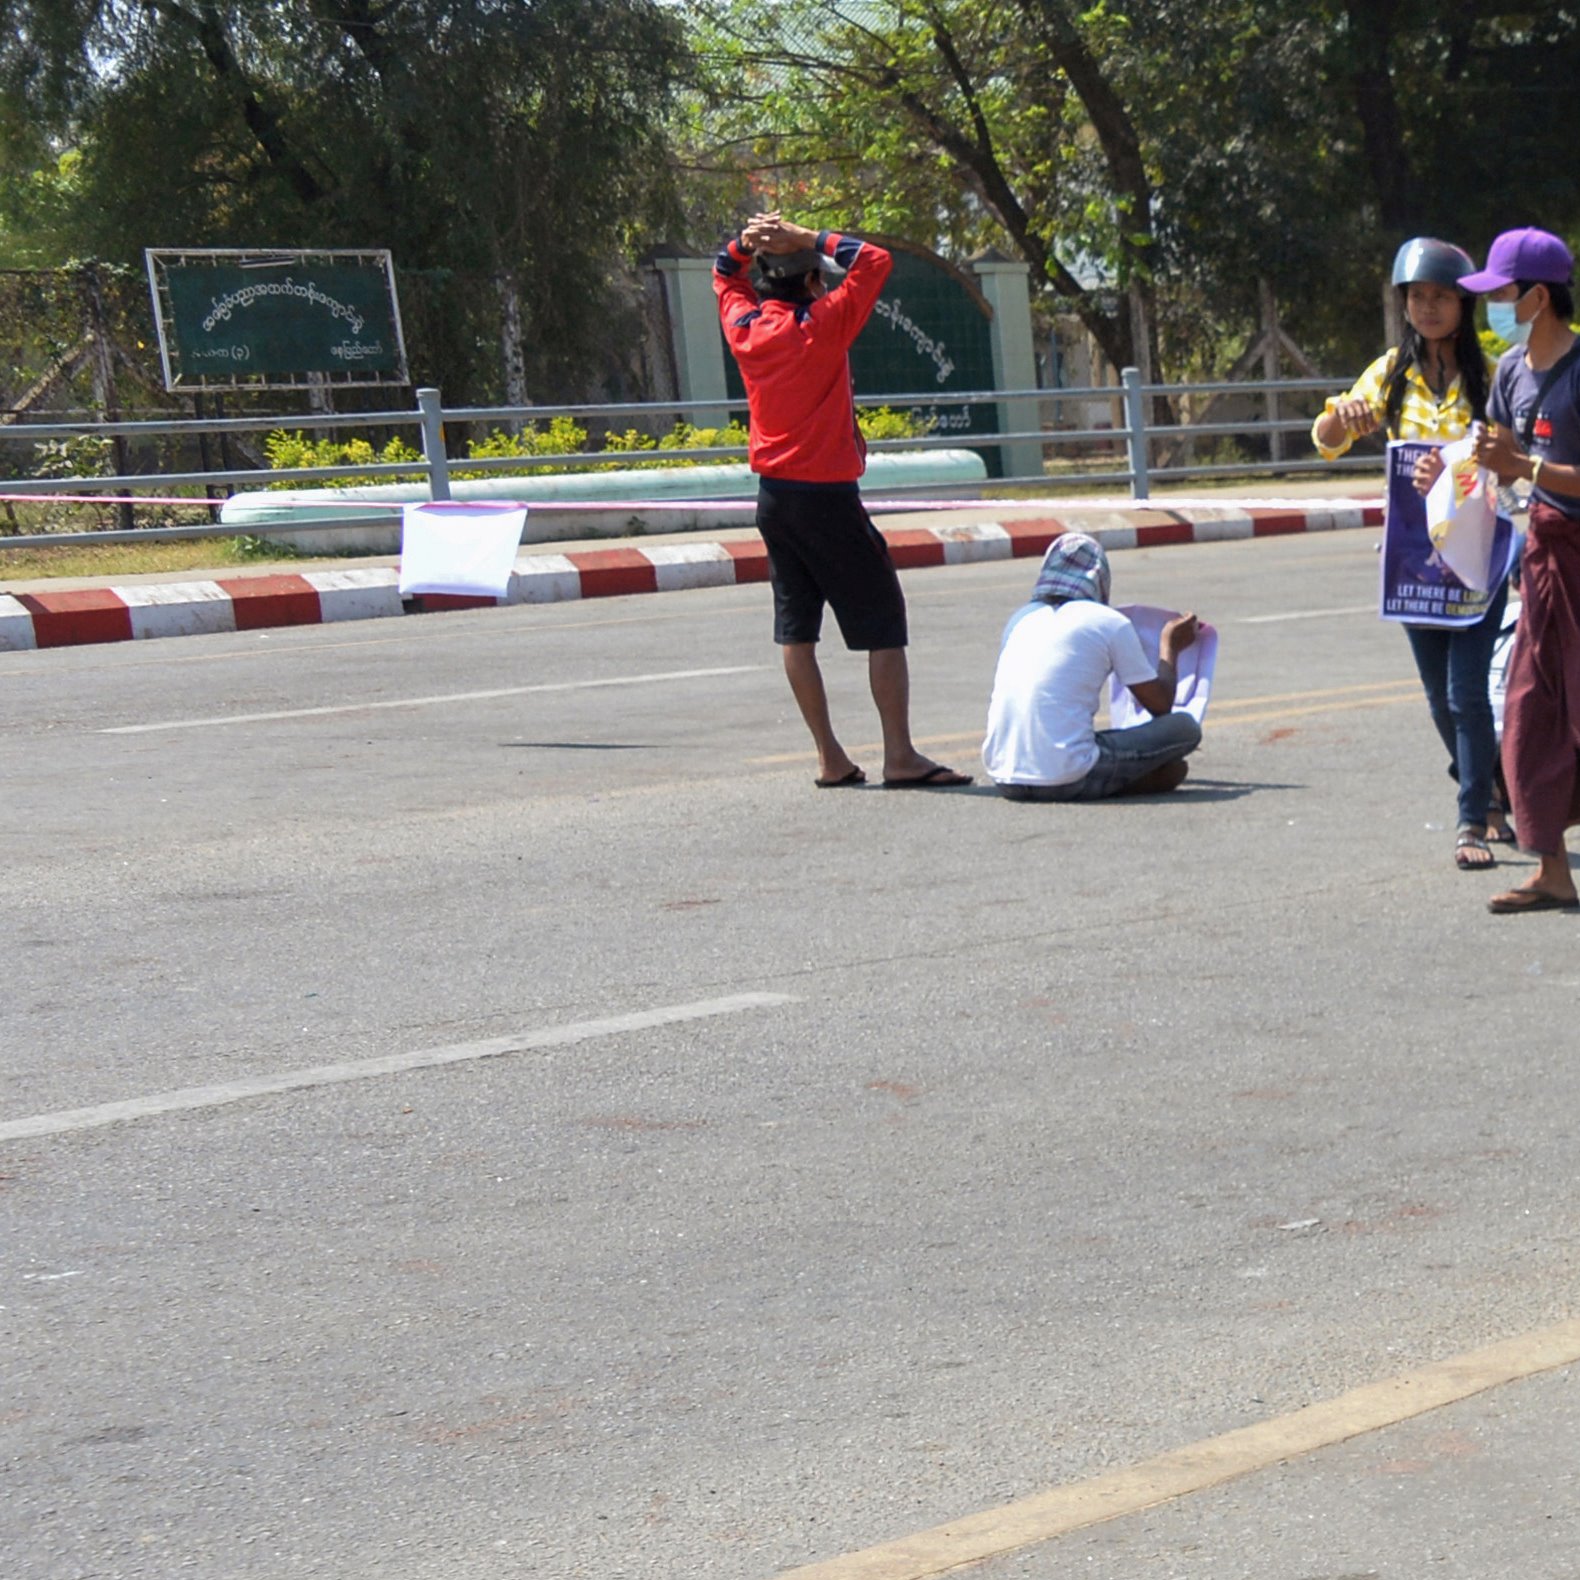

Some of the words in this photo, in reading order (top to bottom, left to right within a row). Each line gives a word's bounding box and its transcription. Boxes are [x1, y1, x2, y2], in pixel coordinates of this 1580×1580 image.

[1397, 585, 1413, 598] LET
[1417, 586, 1446, 600] THERE
[1447, 588, 1461, 602] BE
[1386, 599, 1401, 611] LET
[1403, 600, 1430, 613] THERE
[1431, 602, 1444, 615] BE
